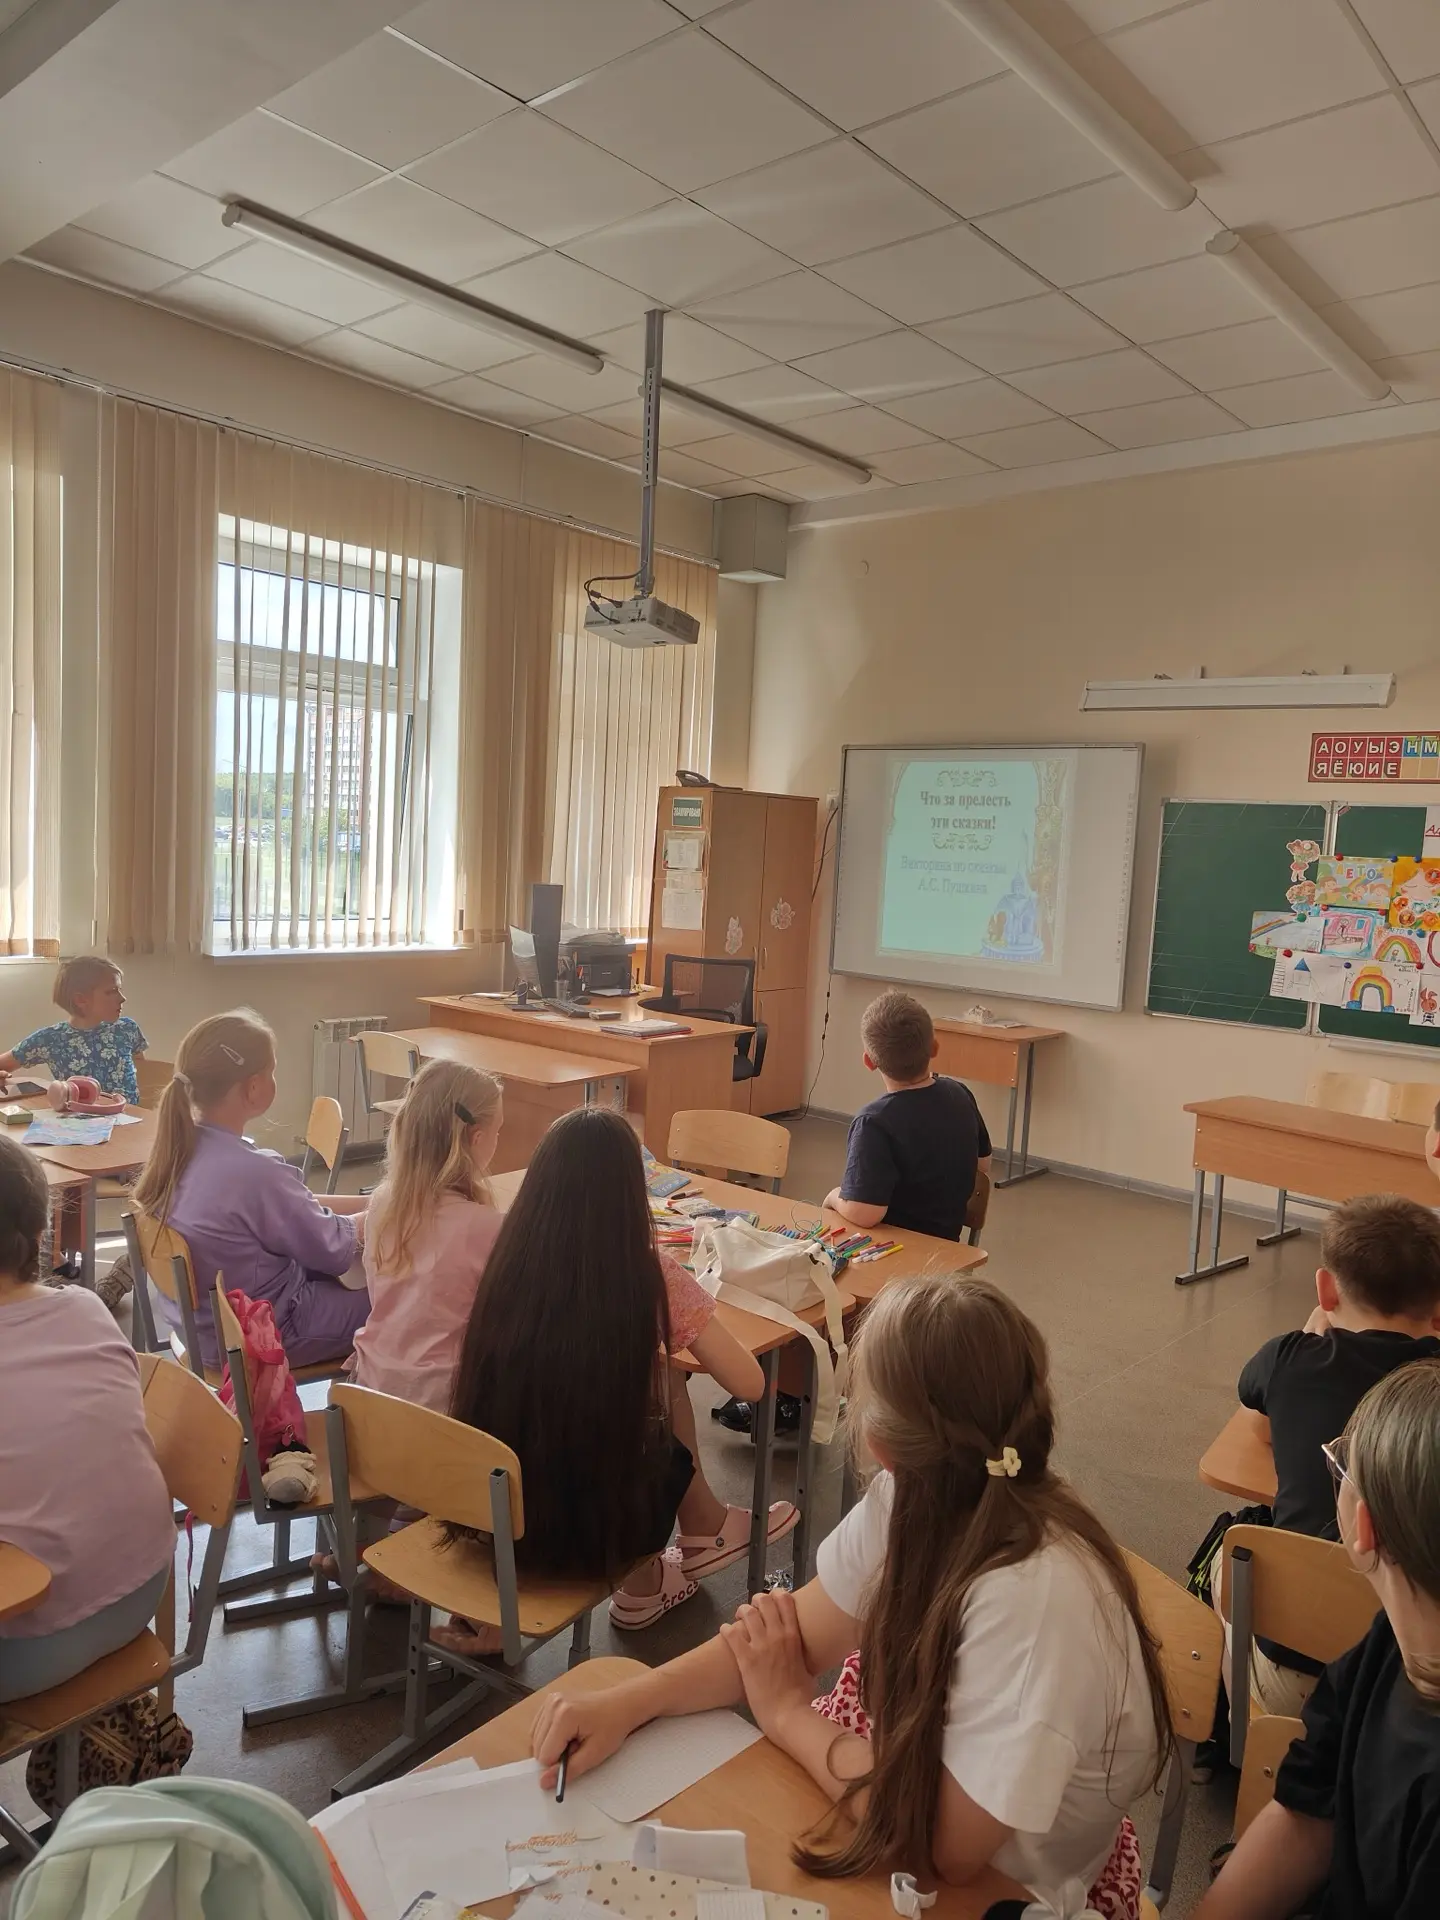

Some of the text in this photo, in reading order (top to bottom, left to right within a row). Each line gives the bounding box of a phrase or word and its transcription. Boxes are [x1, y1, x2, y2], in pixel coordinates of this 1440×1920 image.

[1318, 742, 1437, 753] А О У Ы Э Н М
[1317, 760, 1397, 774] Я Ё Ю И Е
[920, 791, 1011, 809] Что за прелесть
[930, 816, 996, 829] эти сказки!
[1336, 863, 1377, 879] ЛЕТО
[918, 878, 940, 891] А.С.
[663, 1579, 699, 1611] crocs
